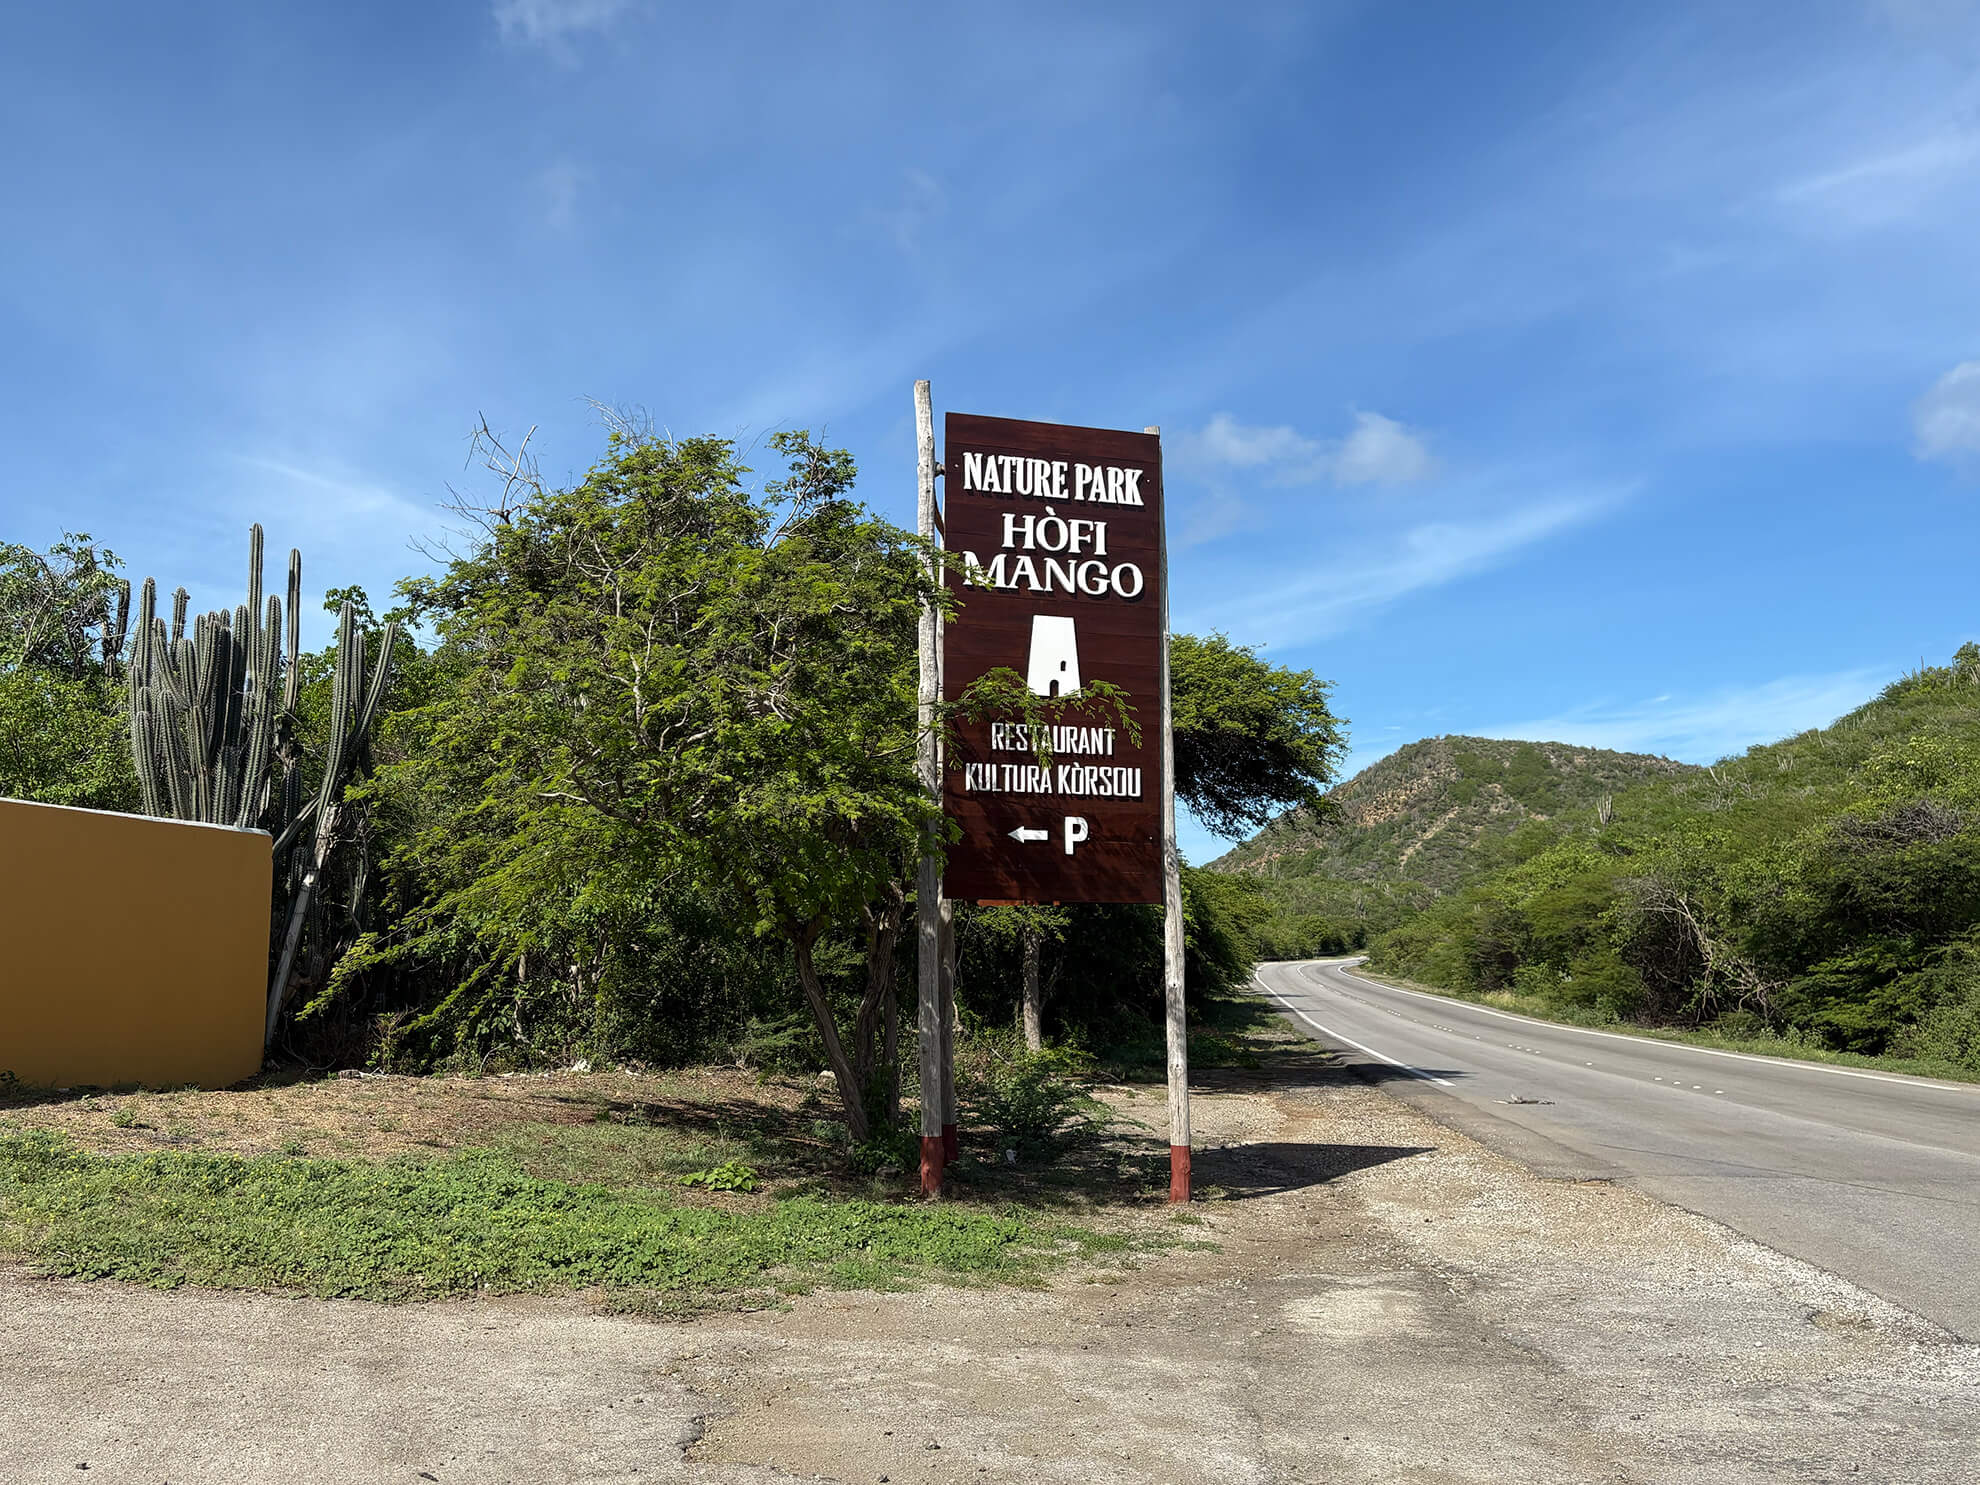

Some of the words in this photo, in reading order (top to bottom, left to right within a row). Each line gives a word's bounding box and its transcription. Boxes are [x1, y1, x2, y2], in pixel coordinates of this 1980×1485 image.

[963, 452, 1069, 499] NATURE
[1074, 463, 1144, 506] PARK
[1001, 506, 1107, 555] HÒFI
[962, 551, 1144, 598] MANGO
[965, 763, 1052, 794] KULTURA
[1057, 762, 1141, 797] KÒRSOU
[1064, 816, 1089, 855] P
